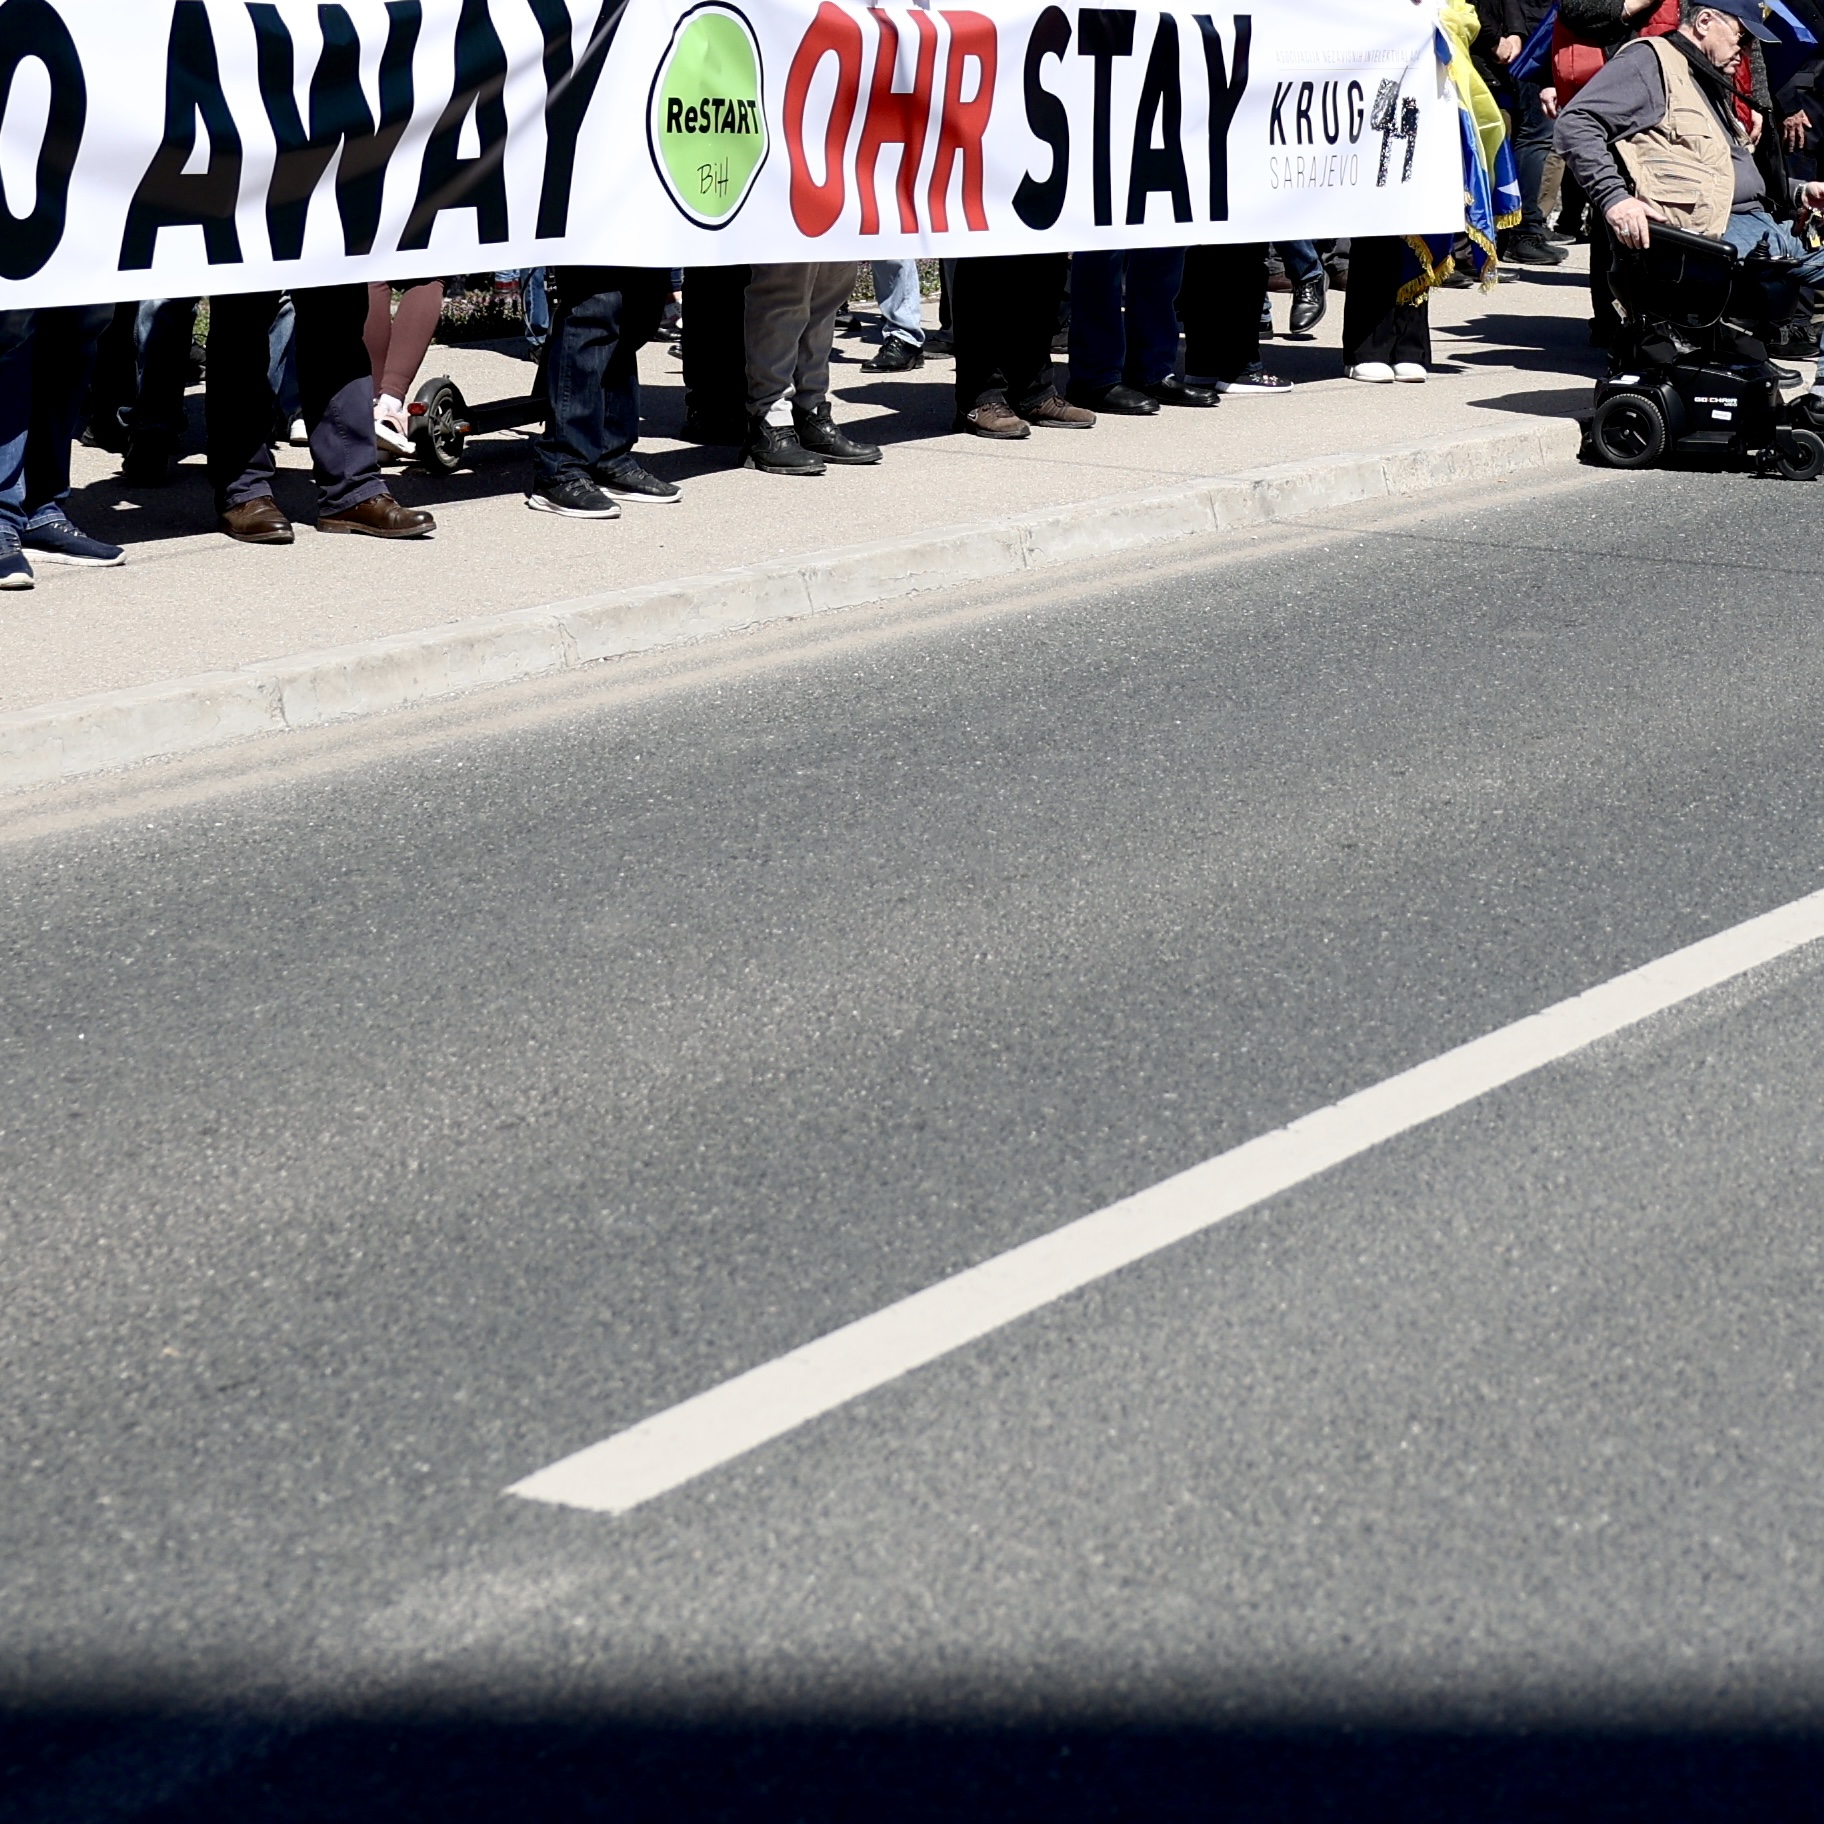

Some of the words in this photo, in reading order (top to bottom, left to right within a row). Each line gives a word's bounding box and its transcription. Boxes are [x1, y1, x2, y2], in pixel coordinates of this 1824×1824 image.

[666, 97, 759, 135] ReSTART
[782, 0, 996, 238] OHR
[1012, 5, 1252, 231] STAY
[1269, 80, 1365, 146] KRUG
[697, 156, 730, 198] BiH
[1269, 153, 1359, 190] SARAJEVO
